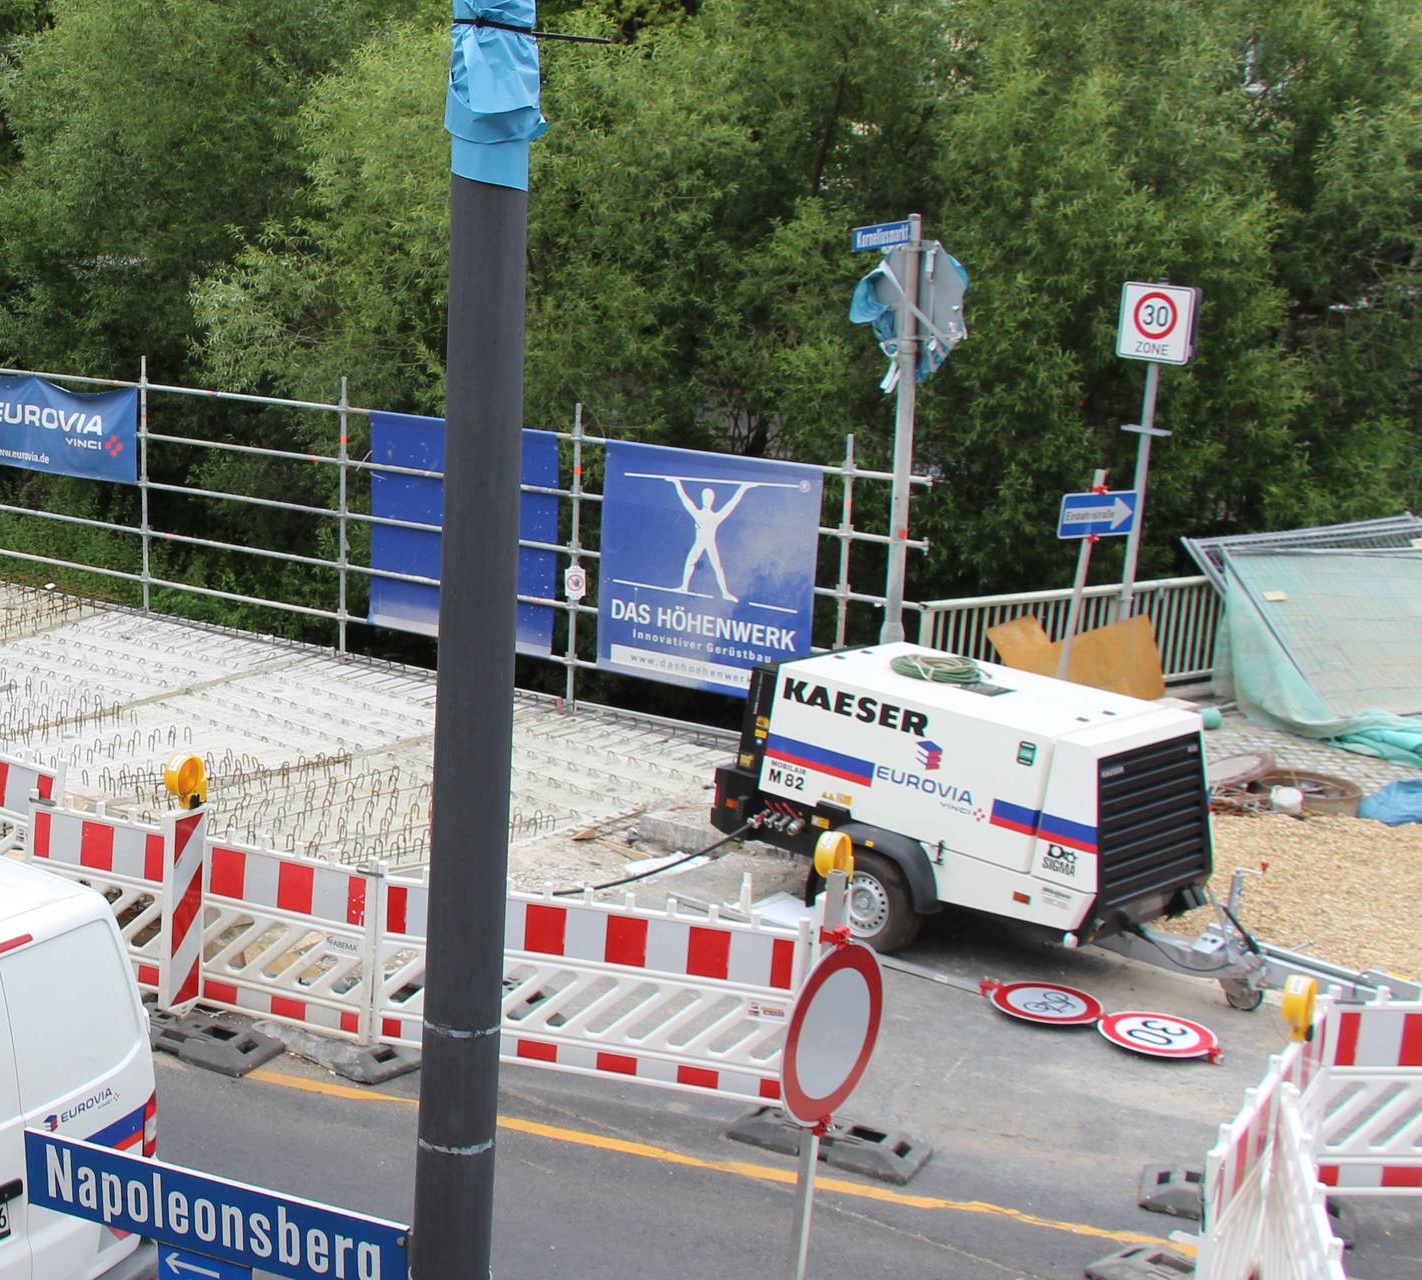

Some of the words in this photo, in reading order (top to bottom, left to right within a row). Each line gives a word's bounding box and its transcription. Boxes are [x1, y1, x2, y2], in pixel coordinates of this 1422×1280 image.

[856, 224, 909, 249] Korneliusmarkt
[1143, 304, 1169, 327] 30
[1135, 341, 1170, 356] ZONE
[65, 437, 102, 450] VINCI
[611, 599, 651, 625] DAS
[657, 605, 796, 652] HÖHENWERK
[632, 629, 703, 651] Innovativer
[706, 643, 772, 664] Gerüstbau
[783, 677, 928, 737] KAESER
[768, 768, 782, 784] M
[784, 773, 805, 791] 82
[771, 760, 806, 775] MOBILAIR
[877, 766, 973, 805] EUROVIA
[940, 801, 971, 816] VINCI
[1042, 856, 1075, 877] SIGMA
[1127, 1020, 1186, 1045] 30
[60, 1087, 112, 1123] EUROVIA
[45, 1144, 381, 1280] Napoleonsberg
